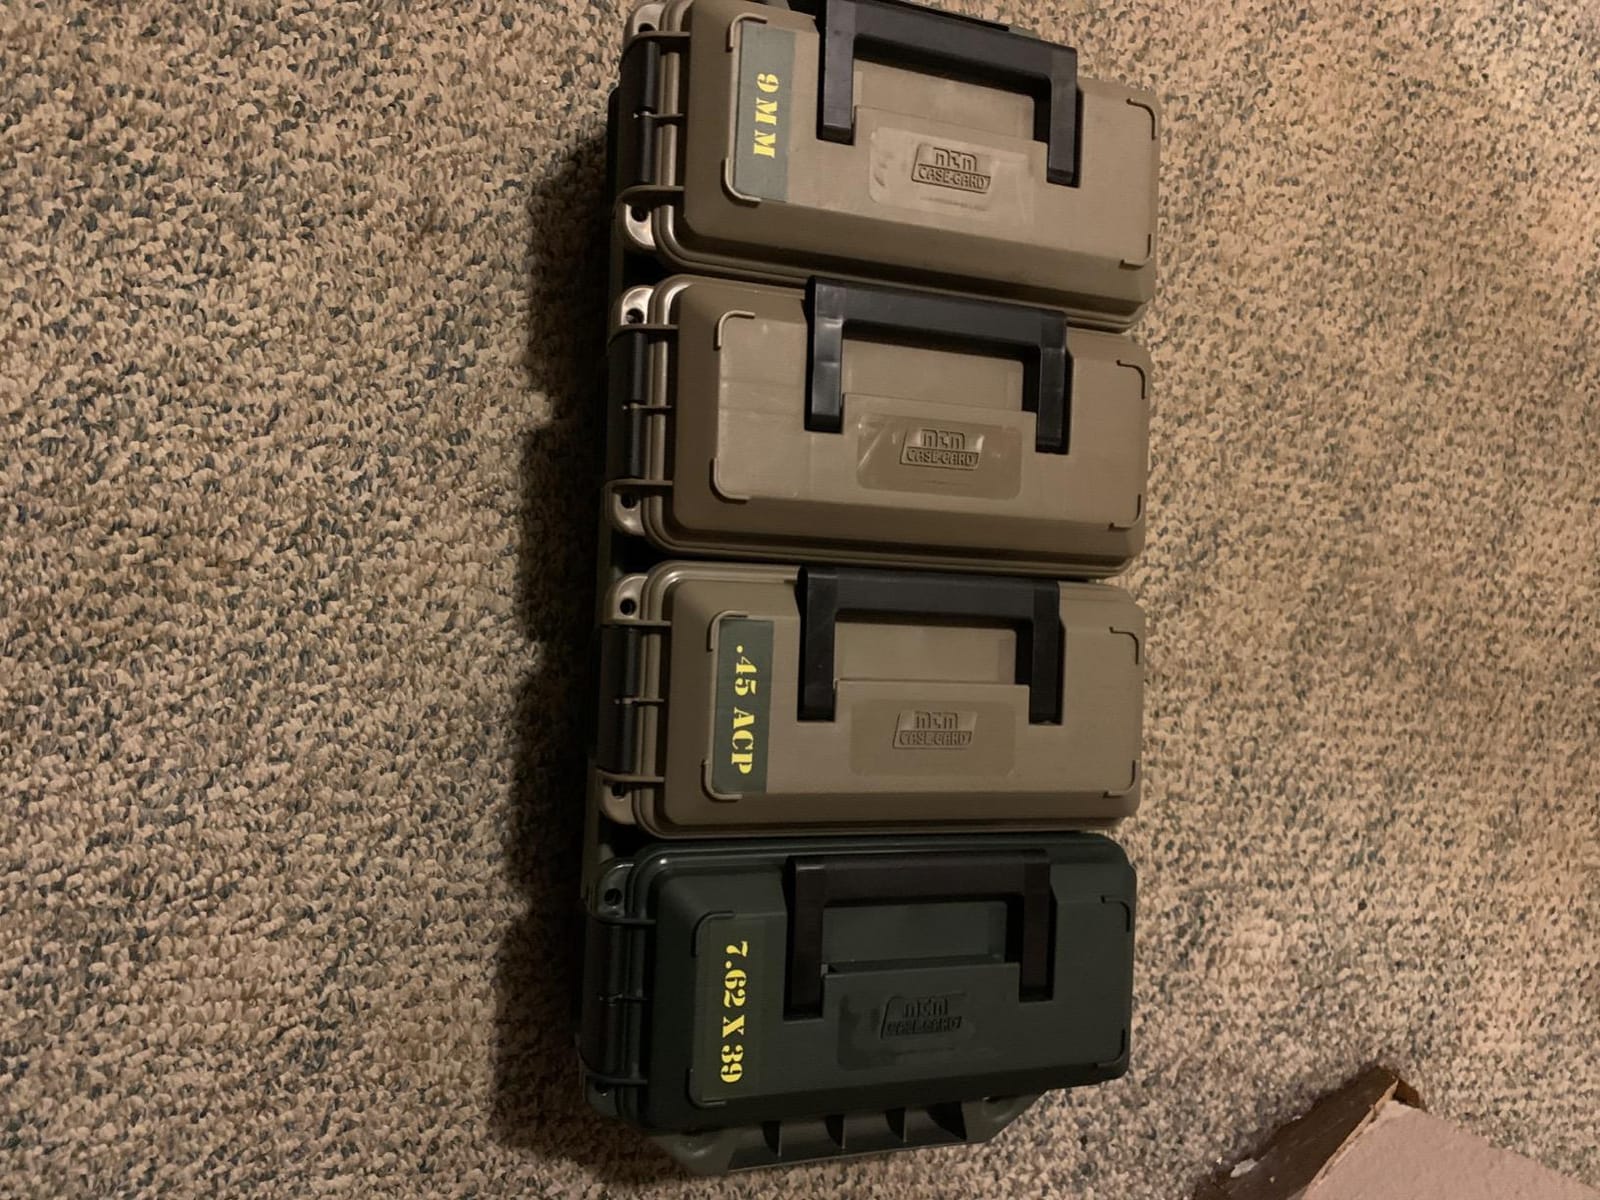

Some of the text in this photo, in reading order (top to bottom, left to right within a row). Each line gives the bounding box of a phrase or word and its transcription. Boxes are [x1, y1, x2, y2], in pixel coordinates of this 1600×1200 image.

[731, 644, 757, 774] .45 ACP
[720, 941, 749, 1083] 7.62 X 39
